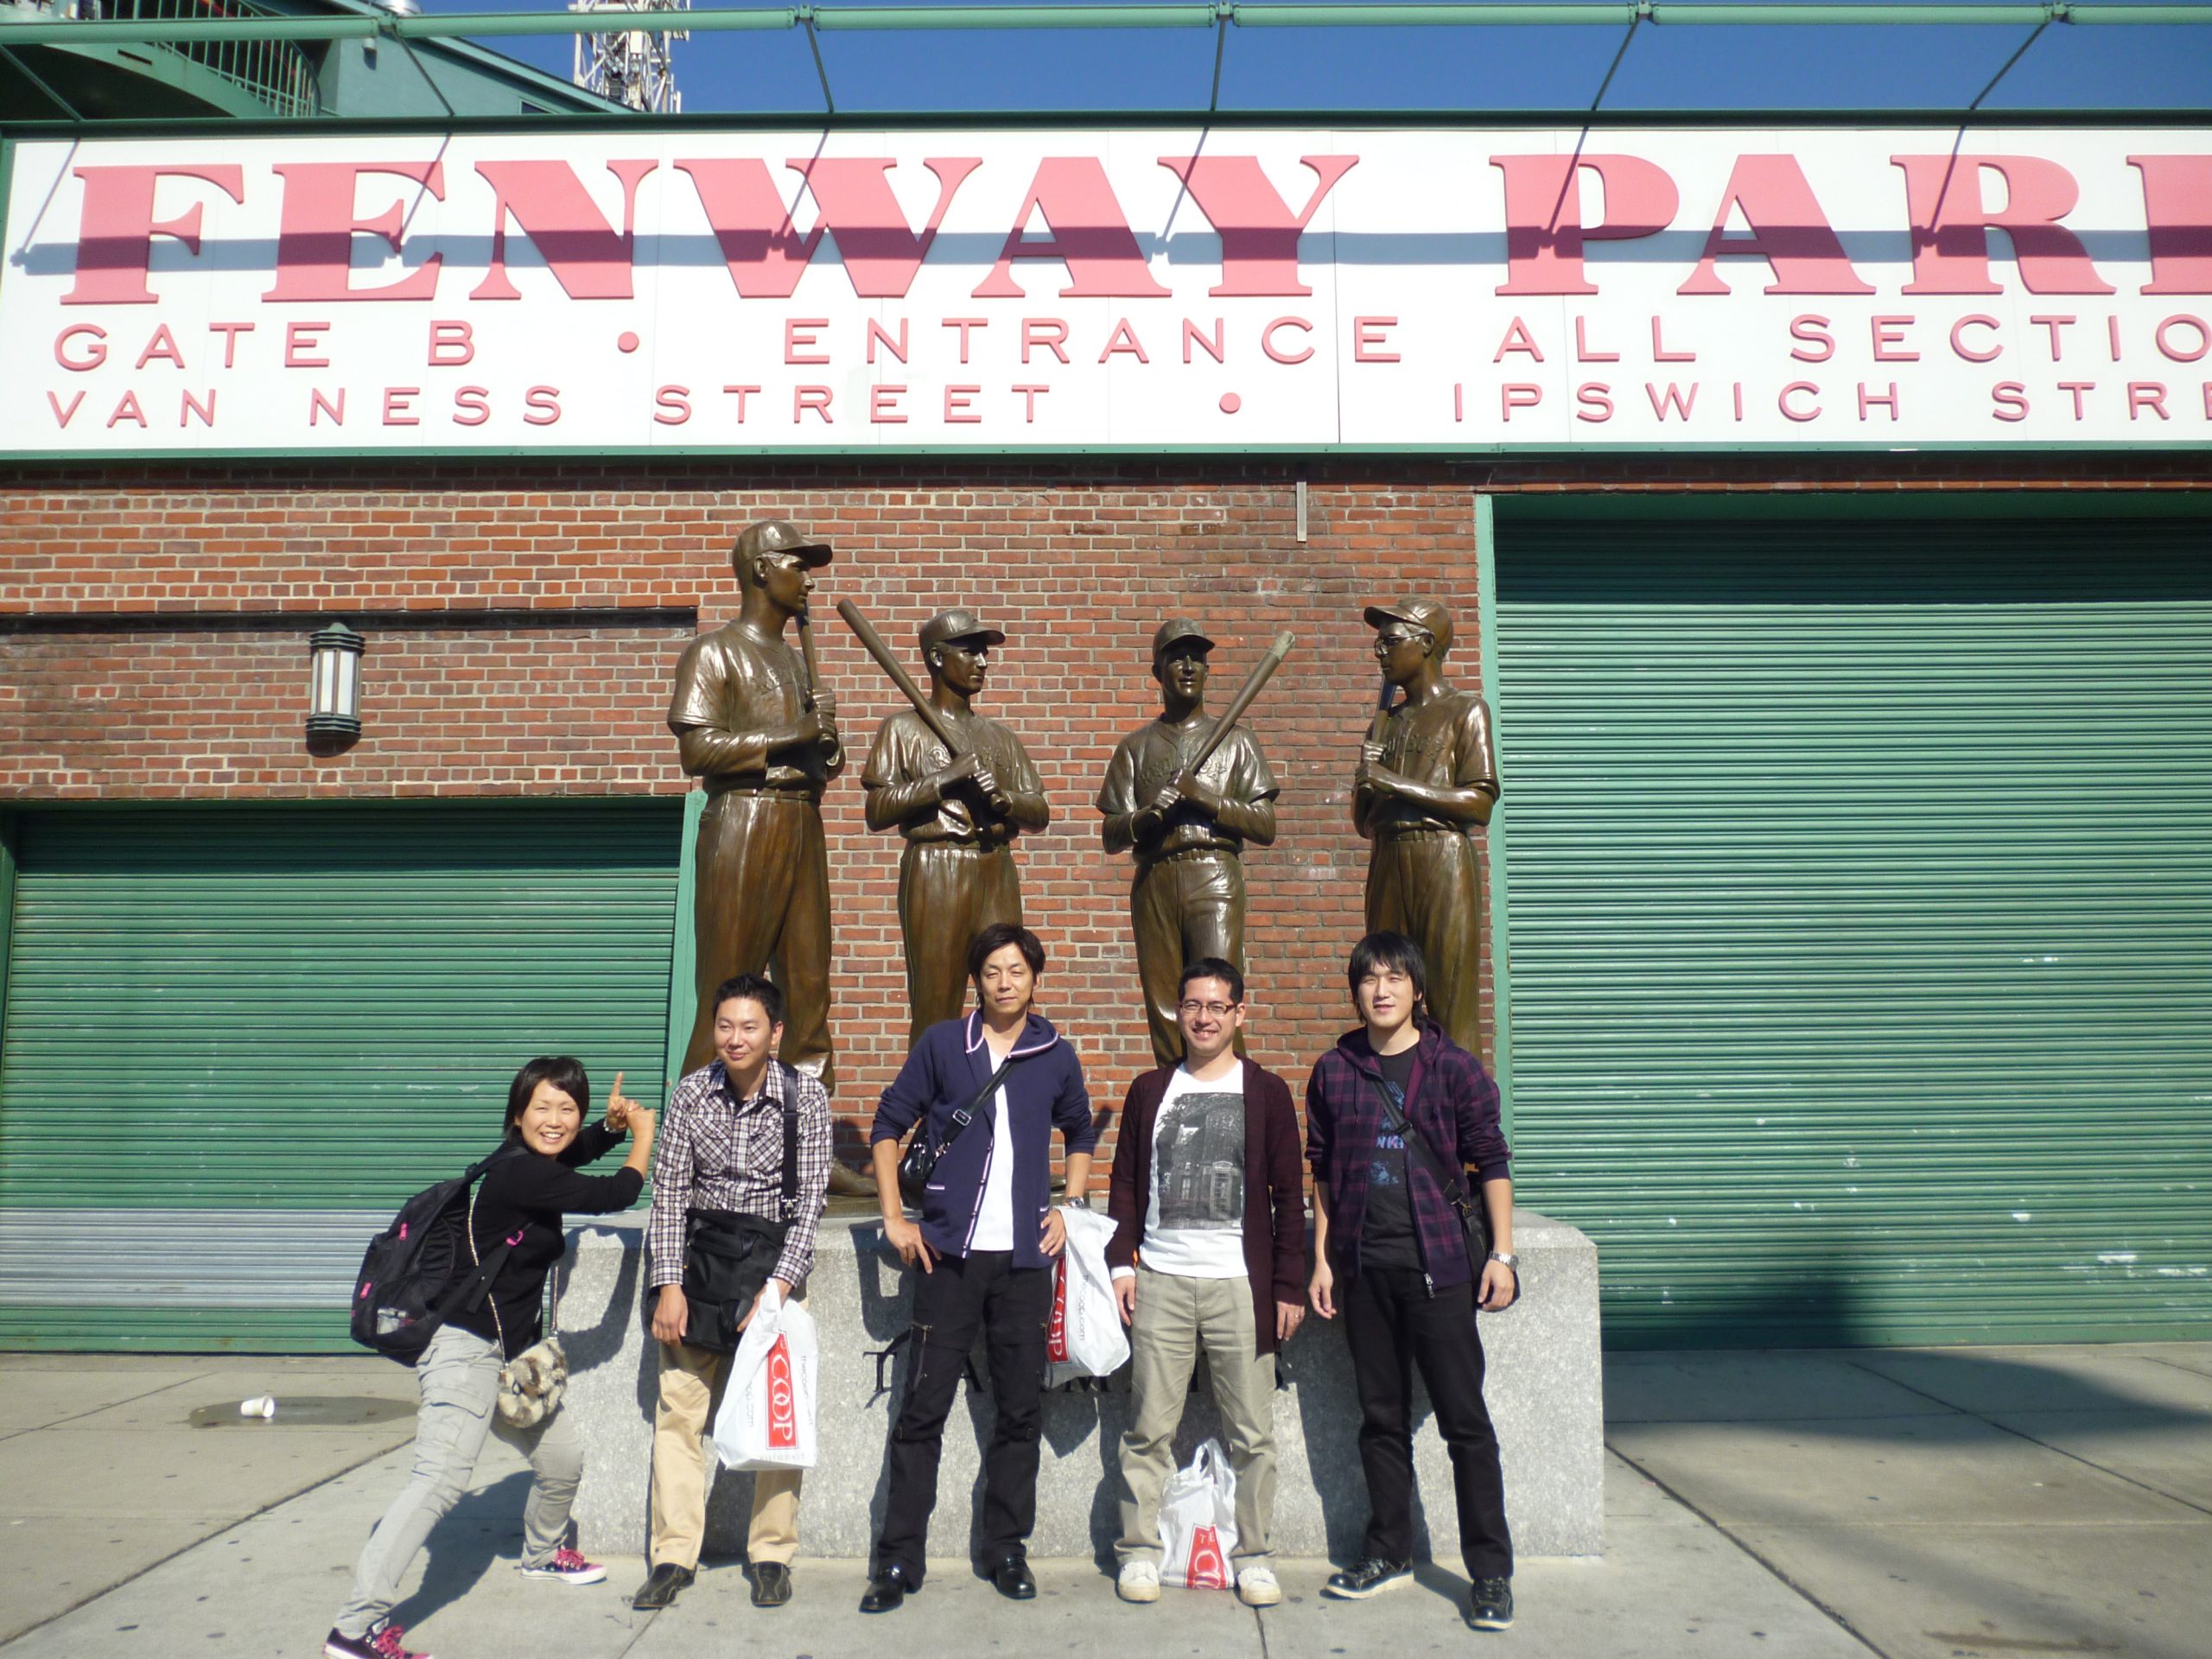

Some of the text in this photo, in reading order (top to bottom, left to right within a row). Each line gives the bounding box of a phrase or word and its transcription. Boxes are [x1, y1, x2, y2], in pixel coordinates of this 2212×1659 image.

[60, 155, 1360, 305] FENWAY
[54, 314, 2212, 372] GATE B ENTRANCE ALL SECTIO
[47, 381, 2212, 429] VAN NESS STREET IPSWICH STR
[772, 1355, 792, 1440] COOP
